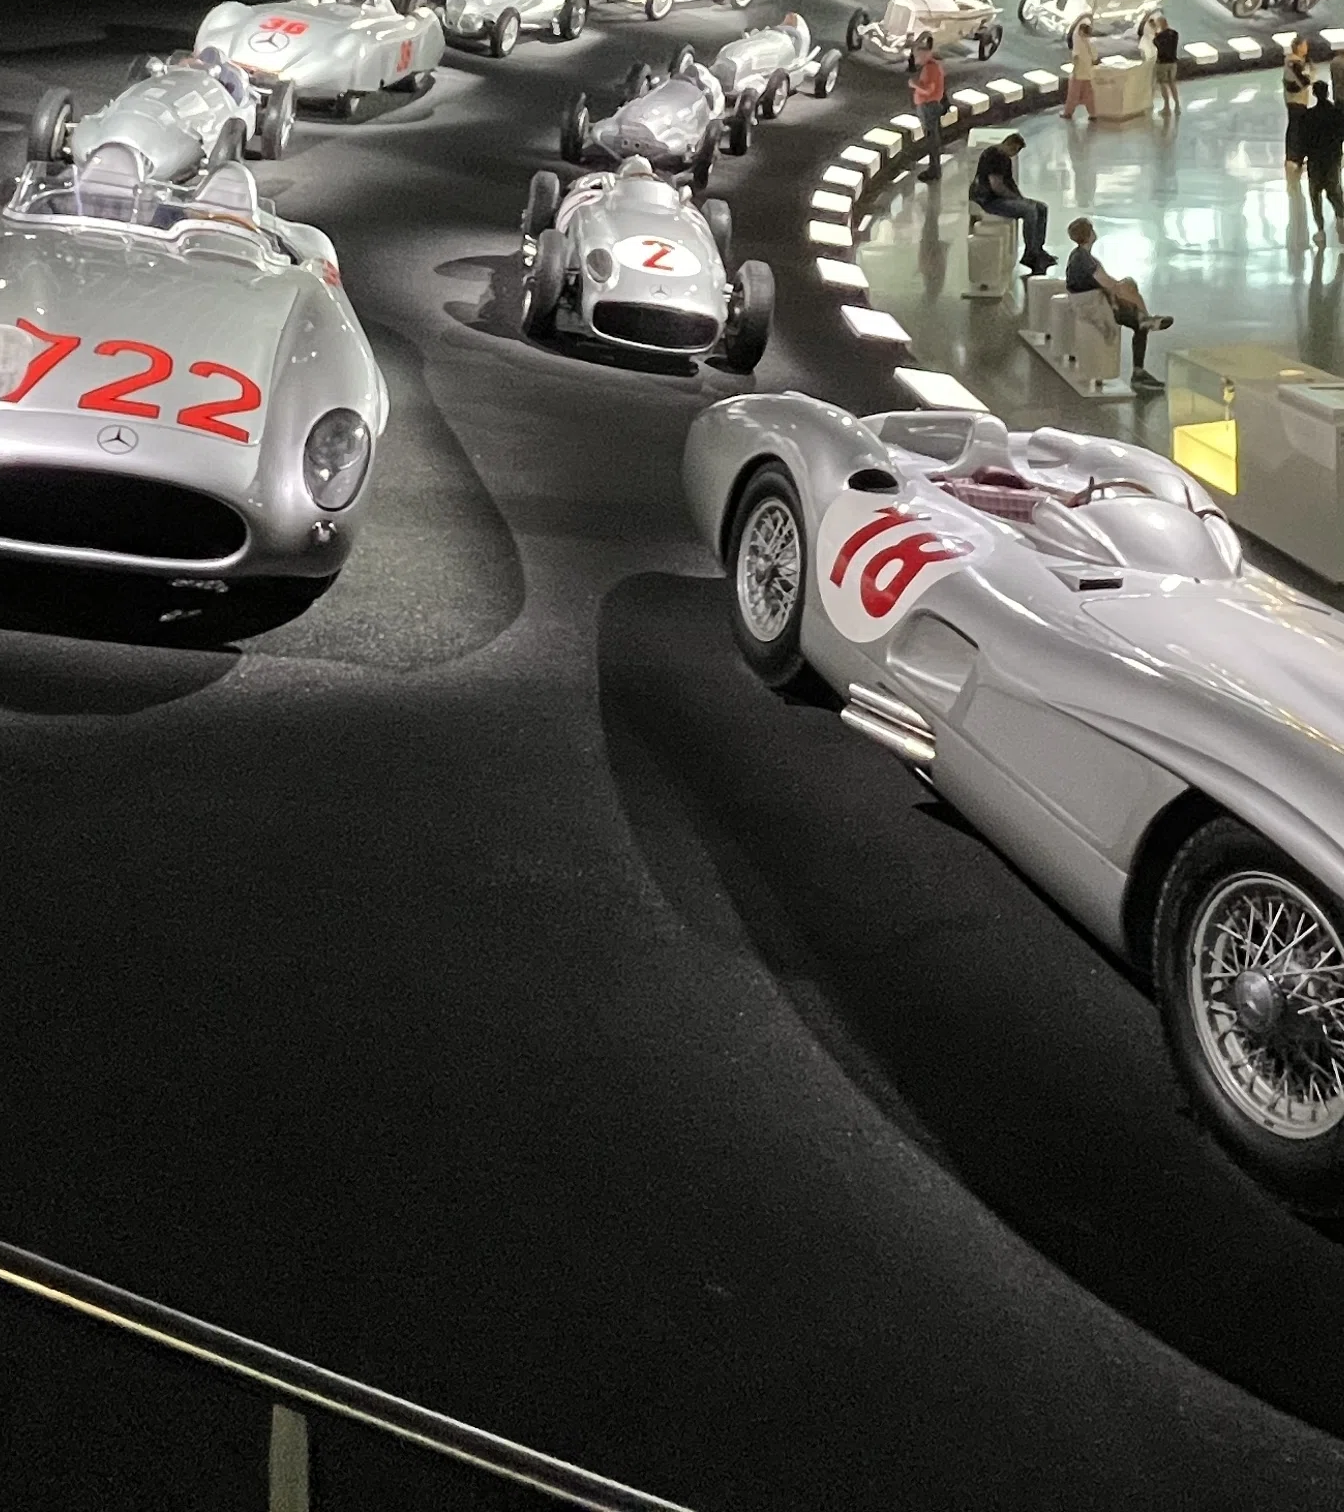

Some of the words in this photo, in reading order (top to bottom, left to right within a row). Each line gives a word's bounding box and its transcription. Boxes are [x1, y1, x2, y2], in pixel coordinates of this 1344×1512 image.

[642, 240, 675, 271] 2
[1, 317, 262, 444] 722
[829, 505, 977, 619] 18
